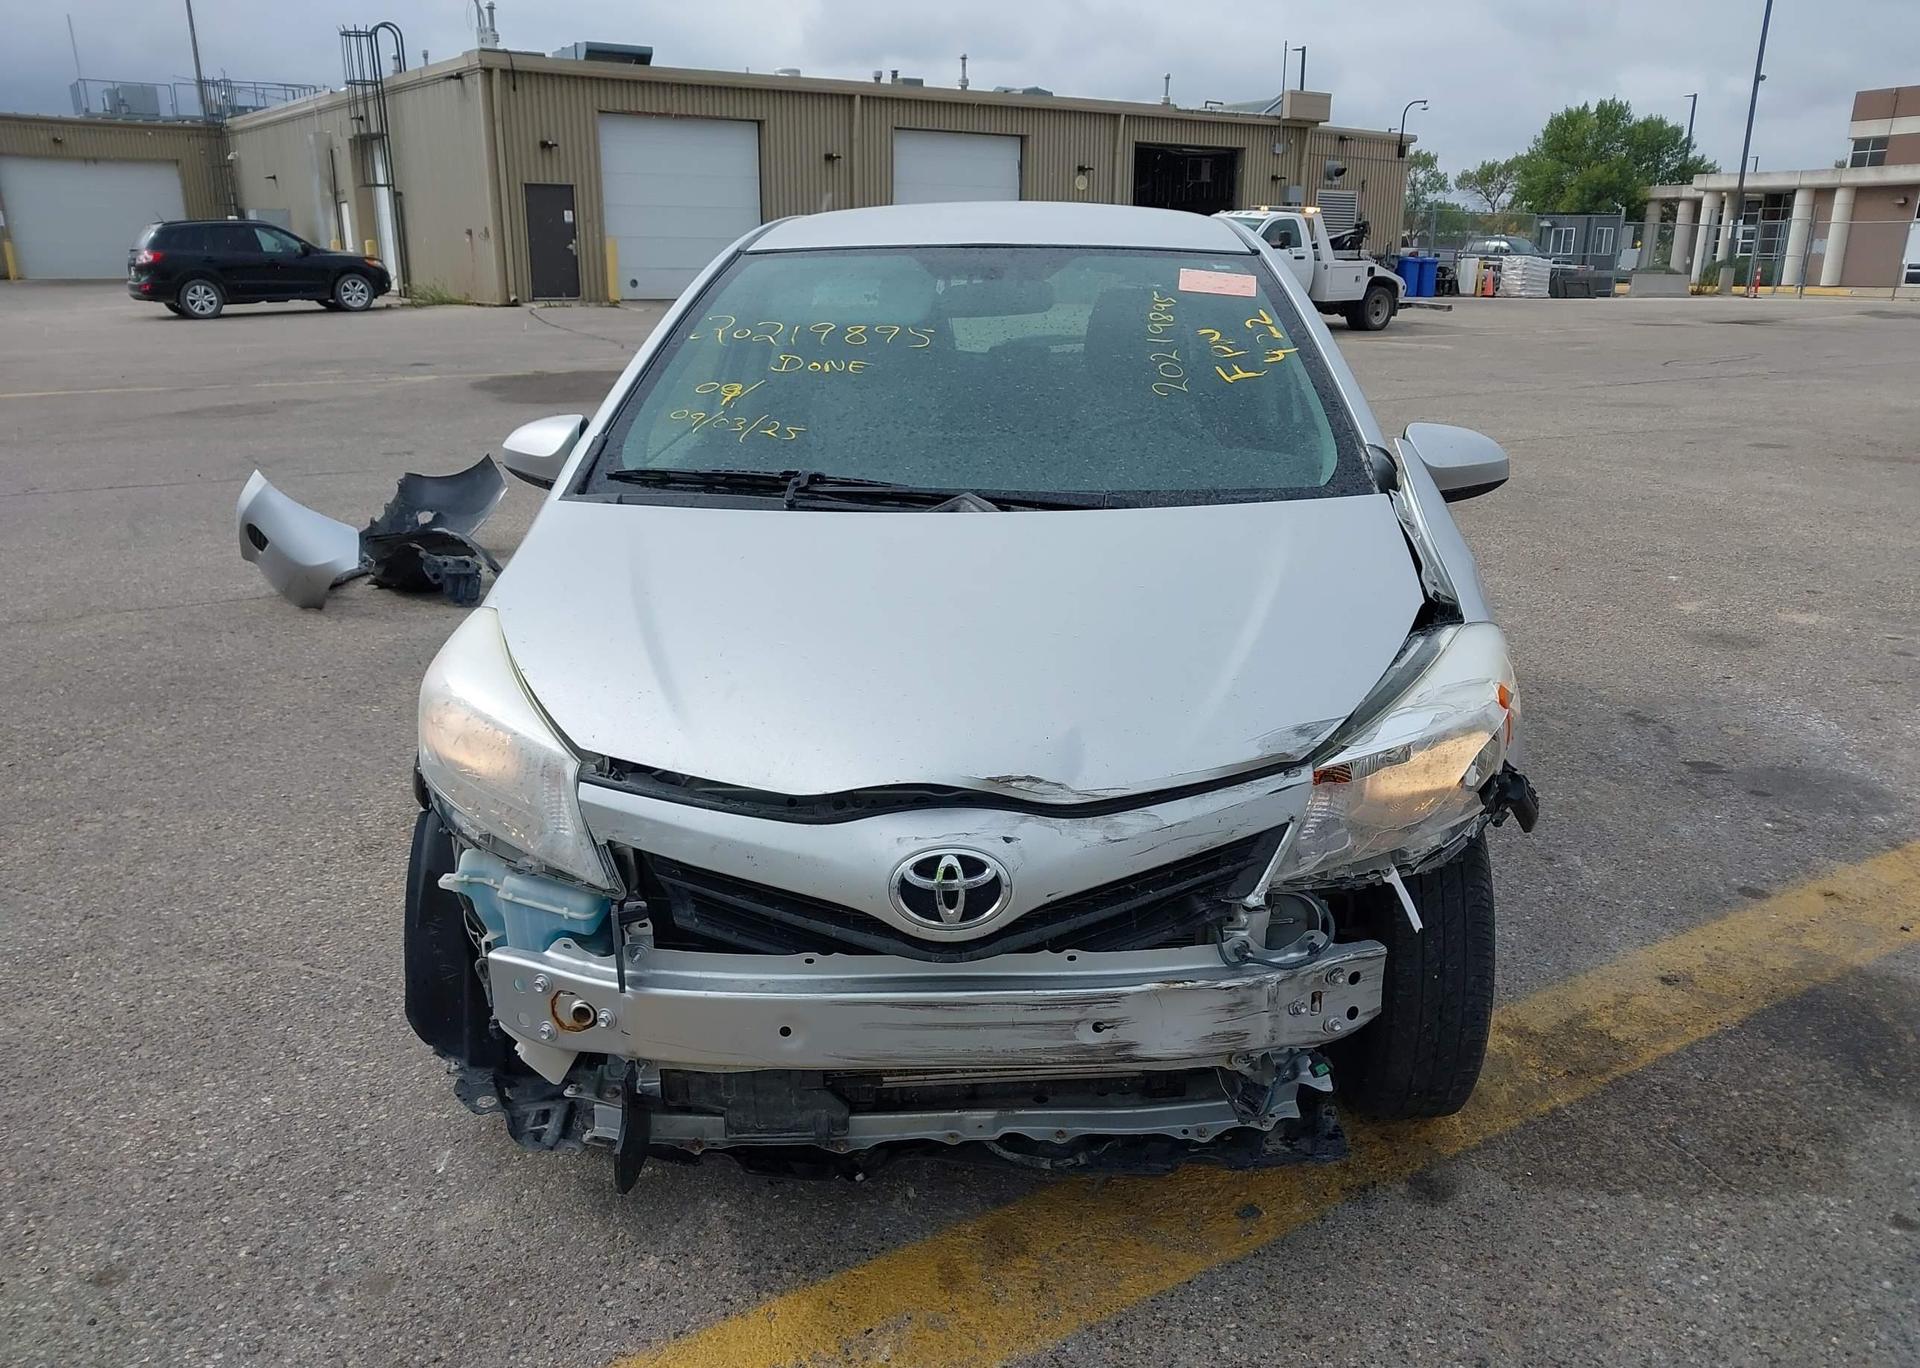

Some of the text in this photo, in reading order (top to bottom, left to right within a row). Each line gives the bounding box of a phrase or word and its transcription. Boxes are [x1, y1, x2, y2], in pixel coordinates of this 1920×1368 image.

[1147, 290, 1189, 396] 20219895
[769, 353, 875, 375] DONE
[669, 408, 808, 444] 09/03/25
